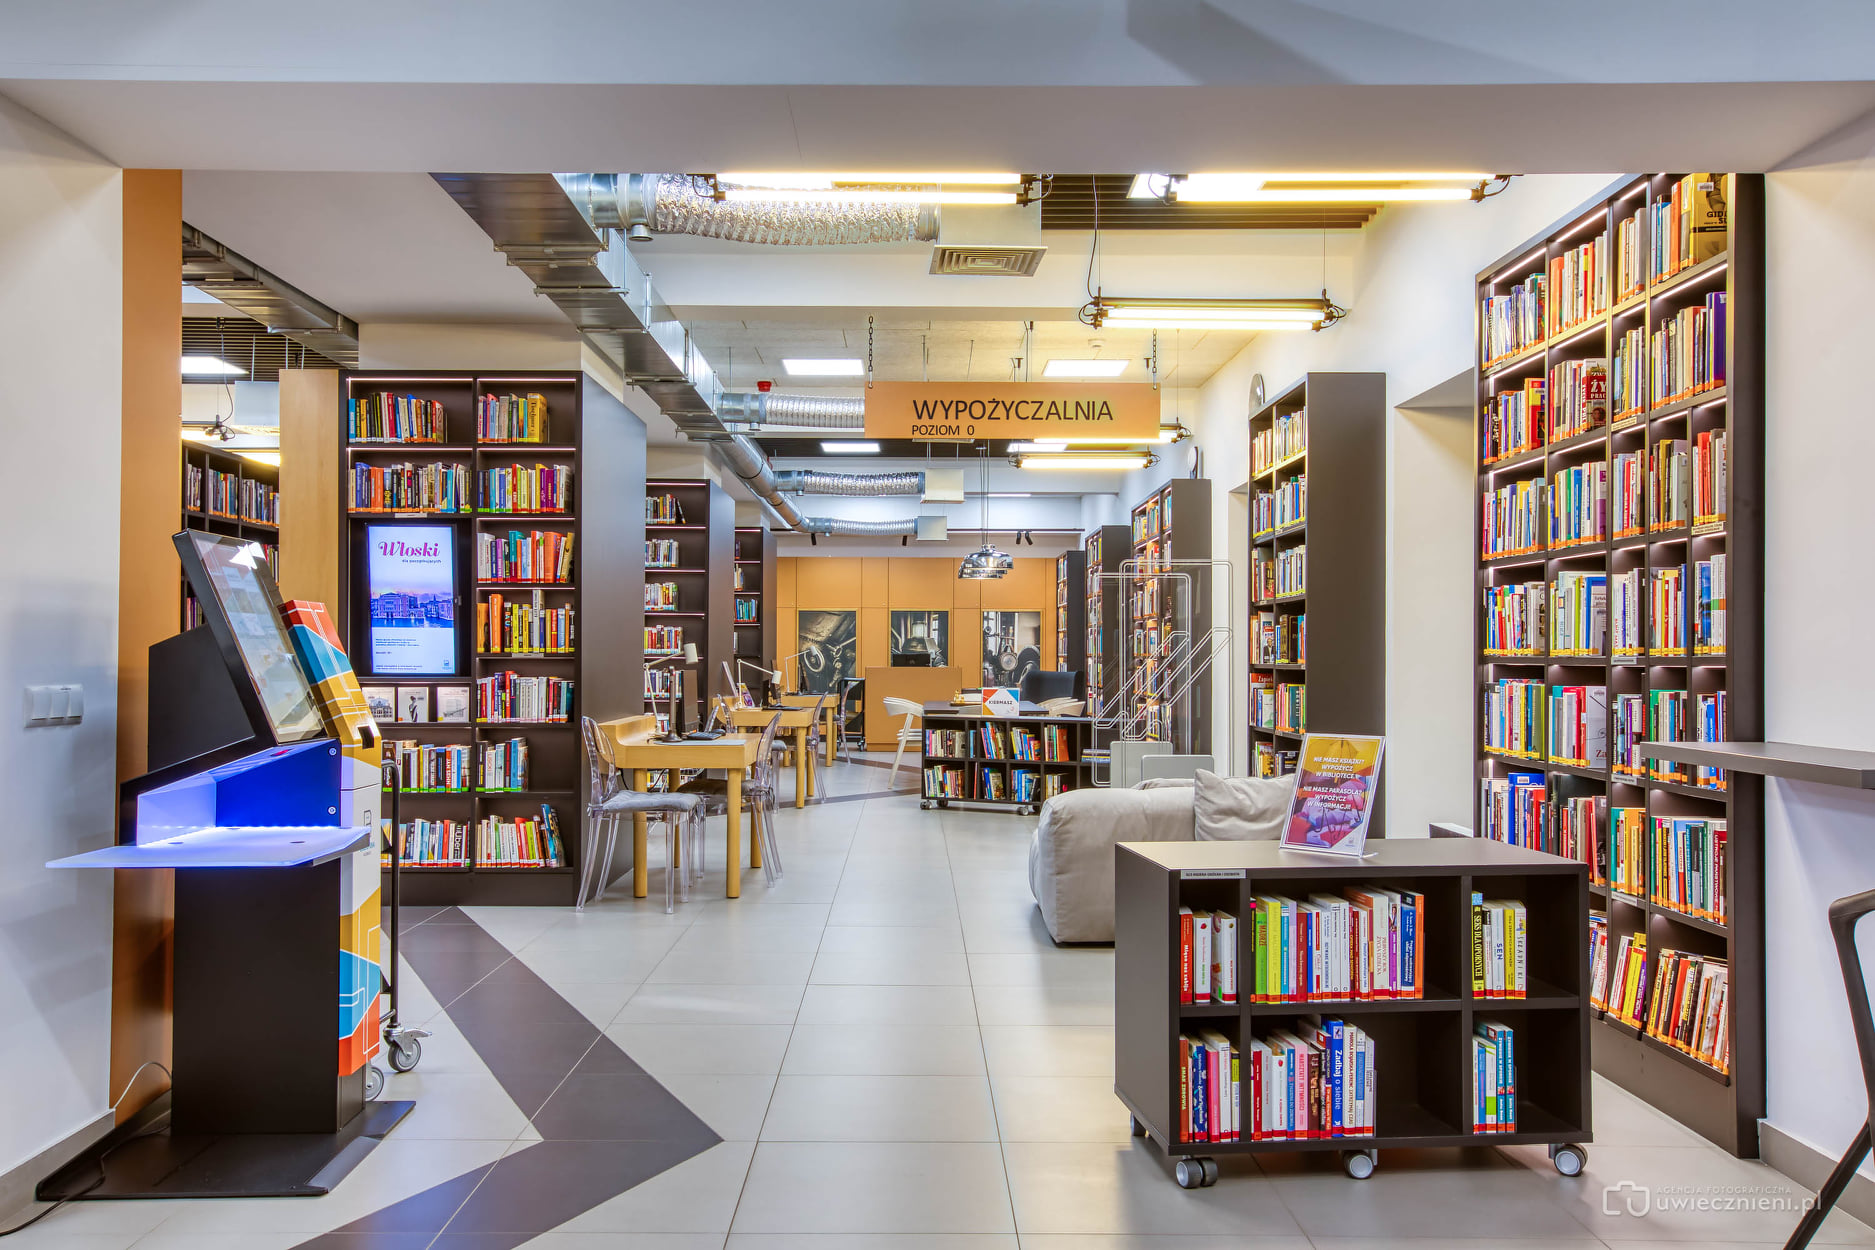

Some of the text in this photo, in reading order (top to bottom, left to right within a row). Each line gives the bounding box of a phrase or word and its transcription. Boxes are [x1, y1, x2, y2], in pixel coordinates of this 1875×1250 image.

[912, 398, 1114, 421] WYPOŻYCZALNIA
[911, 425, 975, 436] POZIOM 0
[1314, 793, 1347, 802] WYPOŻYCZ
[1474, 915, 1483, 977] SEKS DLA OPORNYCH
[1333, 1049, 1342, 1077] Zadbaj
